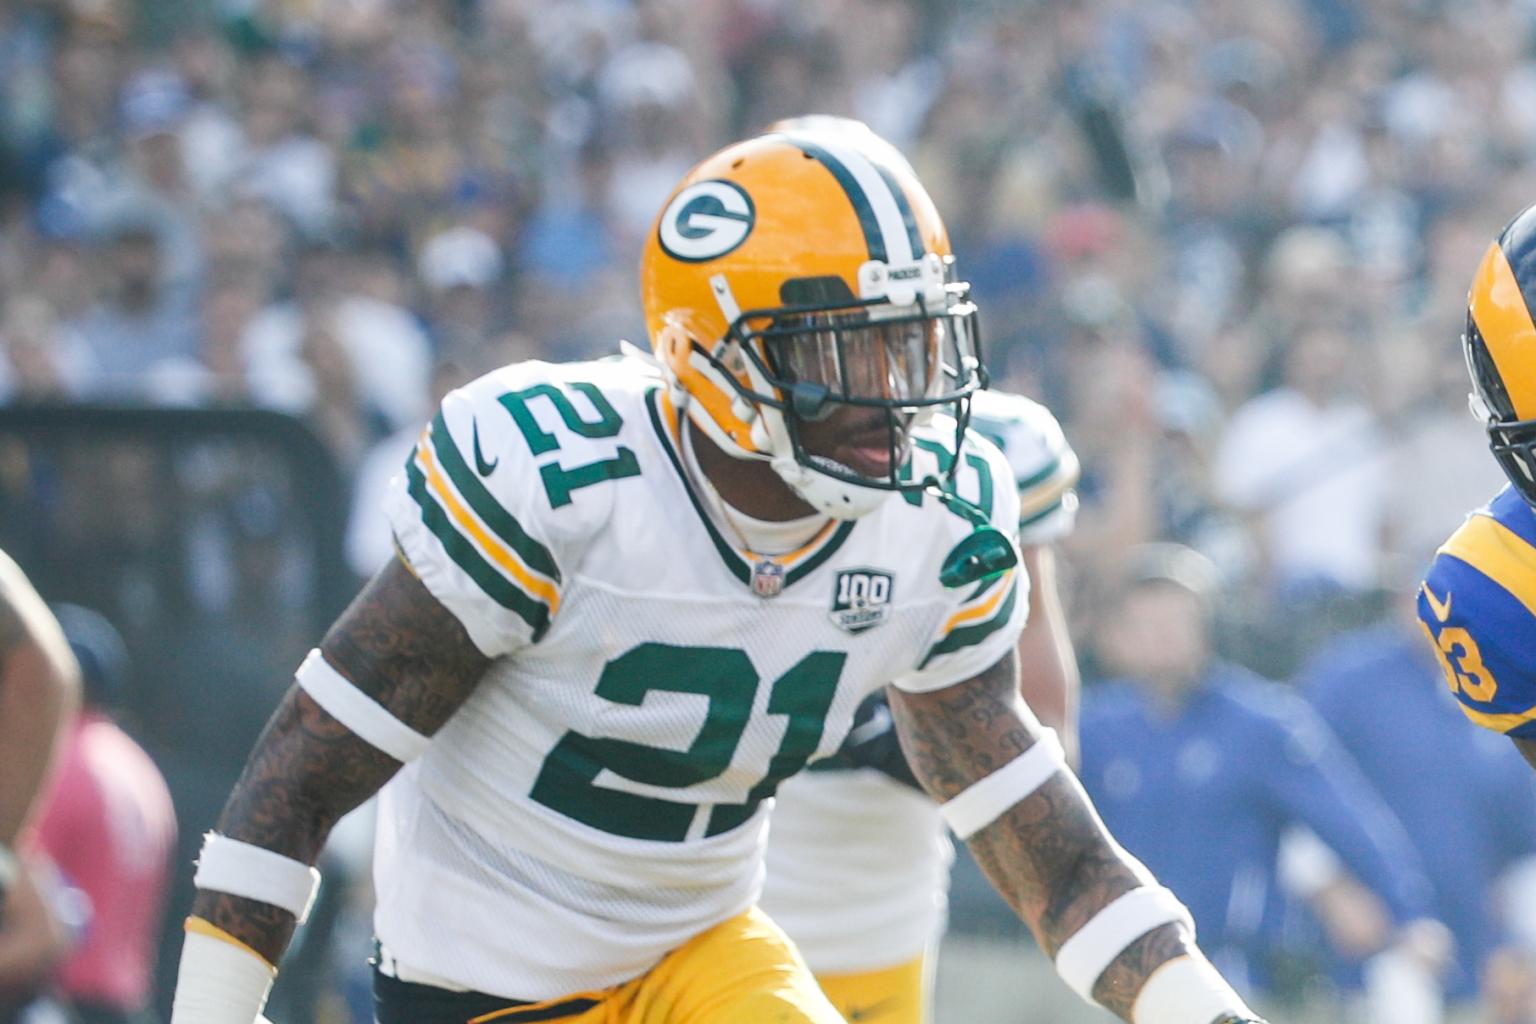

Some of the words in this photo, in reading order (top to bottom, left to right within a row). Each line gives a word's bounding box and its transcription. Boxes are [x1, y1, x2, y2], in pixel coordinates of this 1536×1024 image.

[659, 180, 756, 263] G
[497, 382, 642, 510] 21
[838, 573, 890, 607] 100
[528, 641, 848, 843] 21
